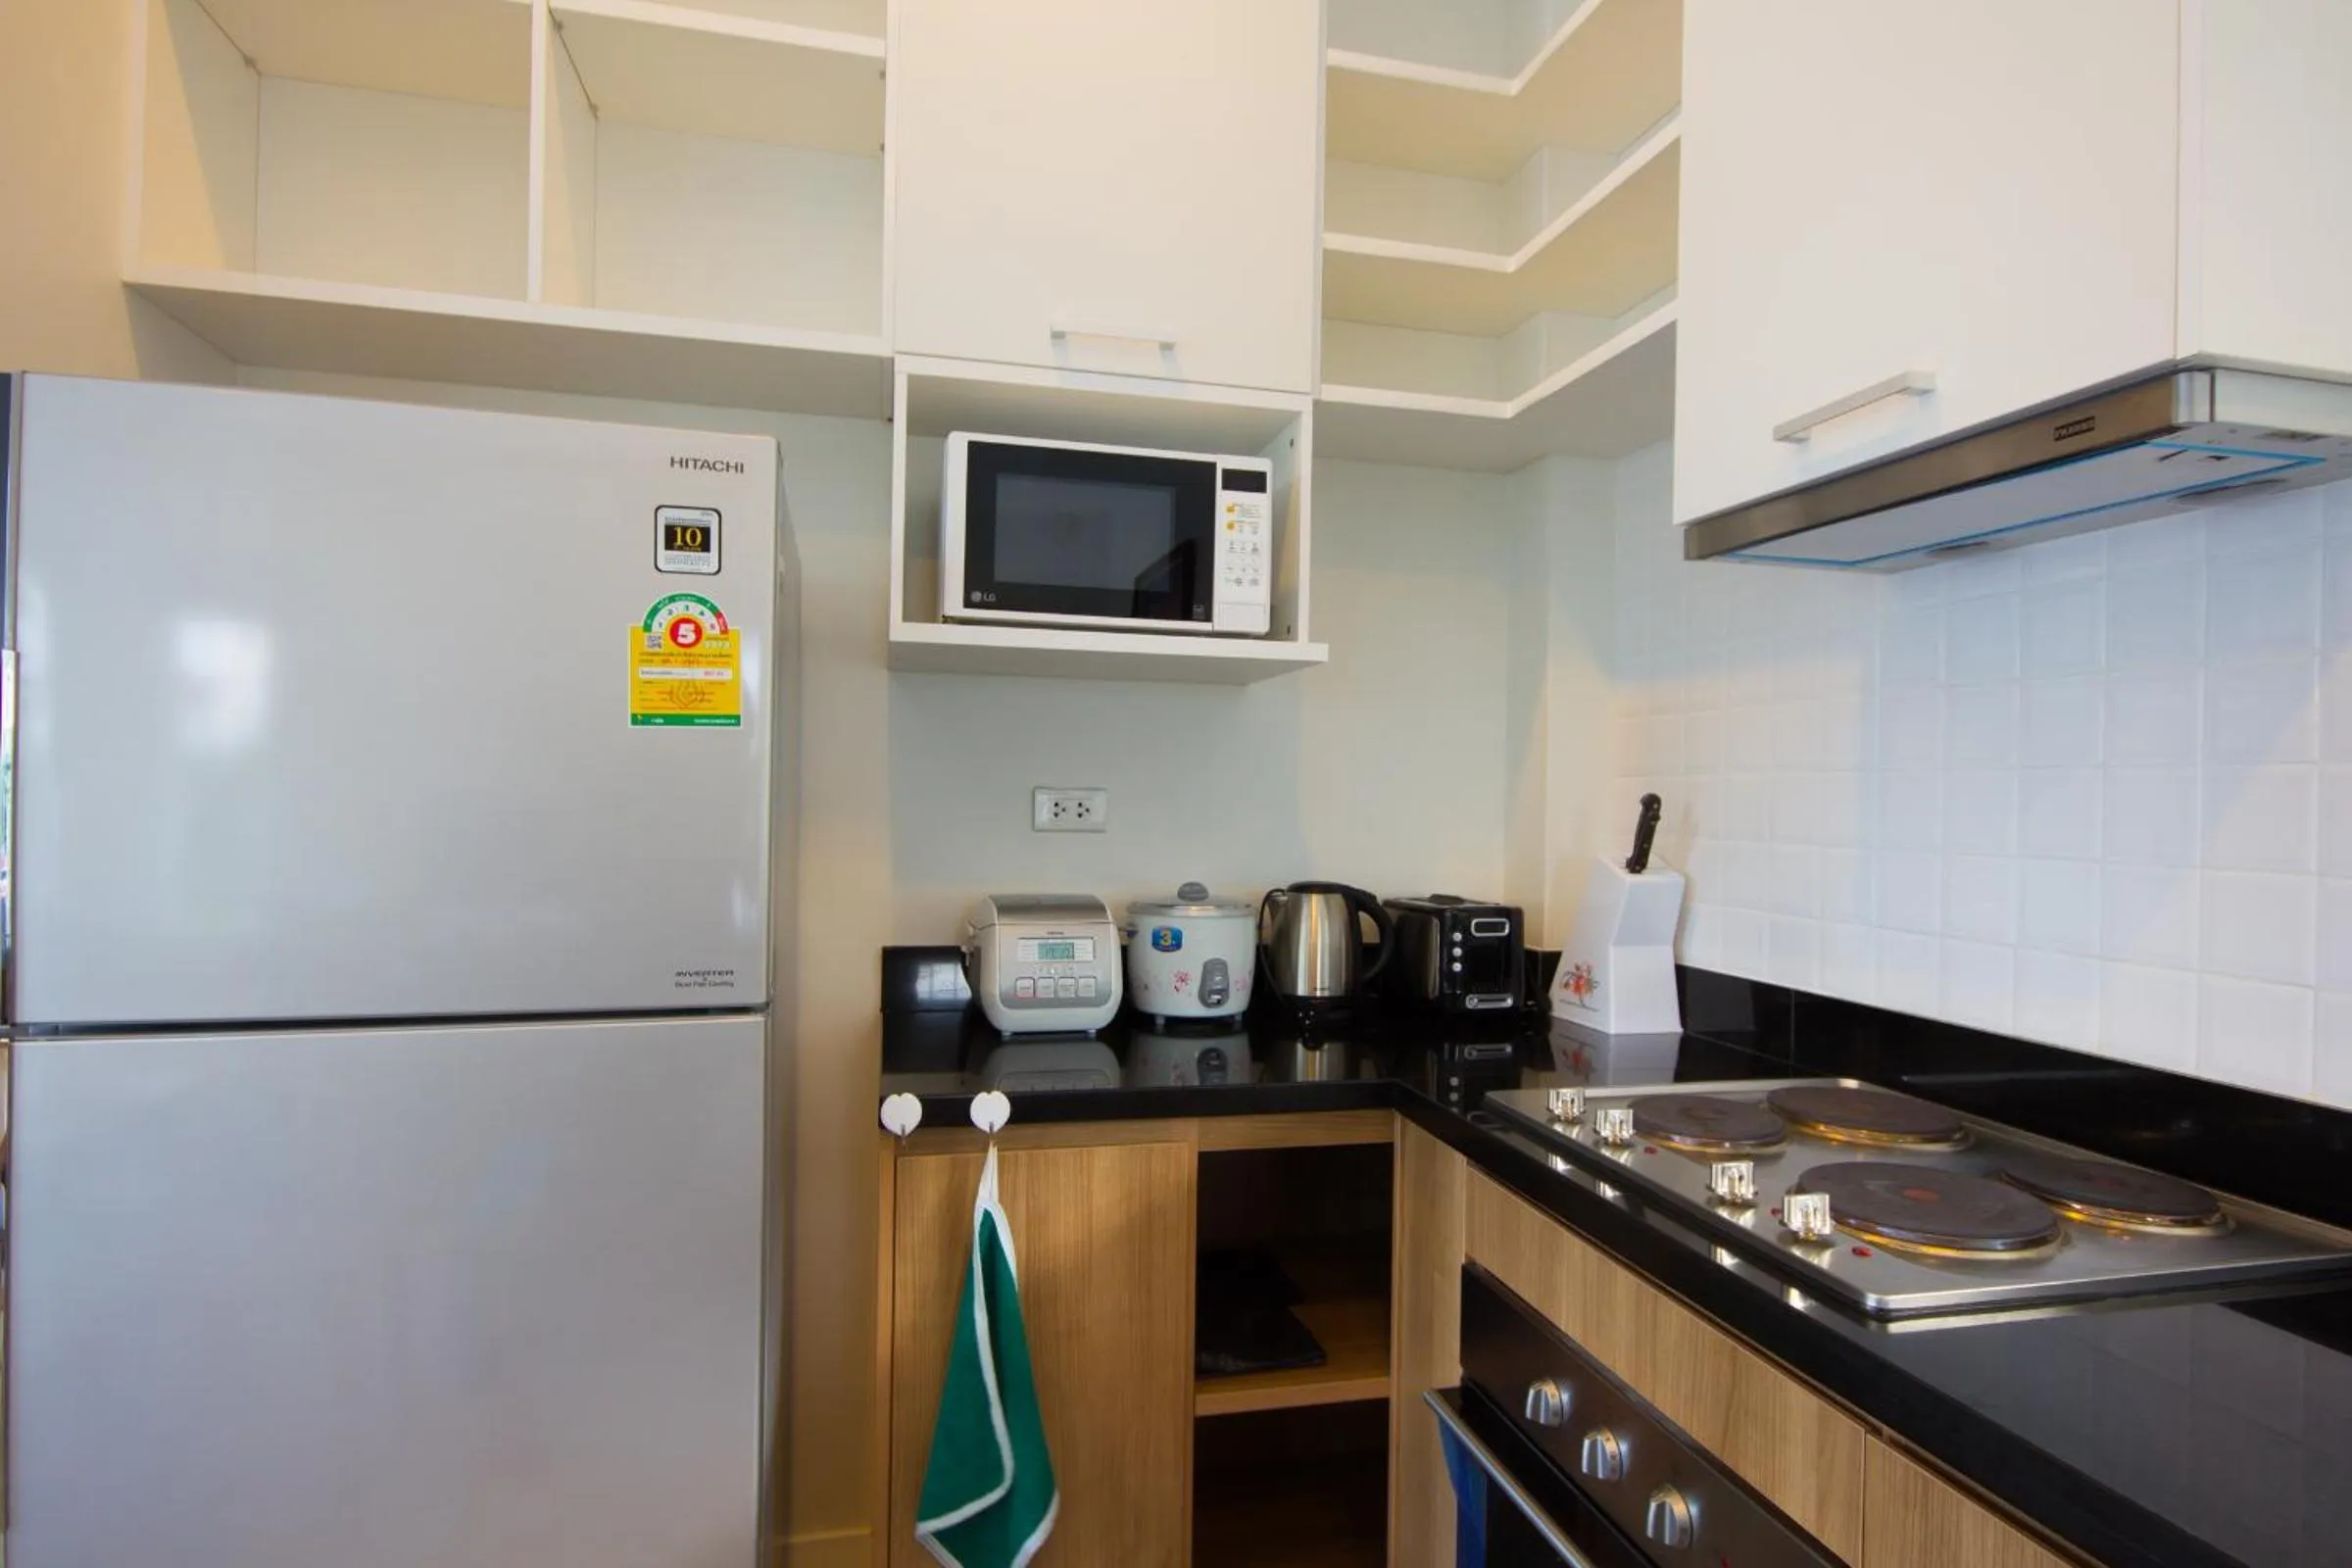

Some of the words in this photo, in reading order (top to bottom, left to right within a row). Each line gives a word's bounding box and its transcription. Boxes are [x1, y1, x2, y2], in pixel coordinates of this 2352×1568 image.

[670, 457, 745, 474] HITACHI
[672, 526, 703, 547] 10
[983, 591, 997, 602] LG
[676, 622, 698, 645] 5
[1159, 929, 1172, 947] 3
